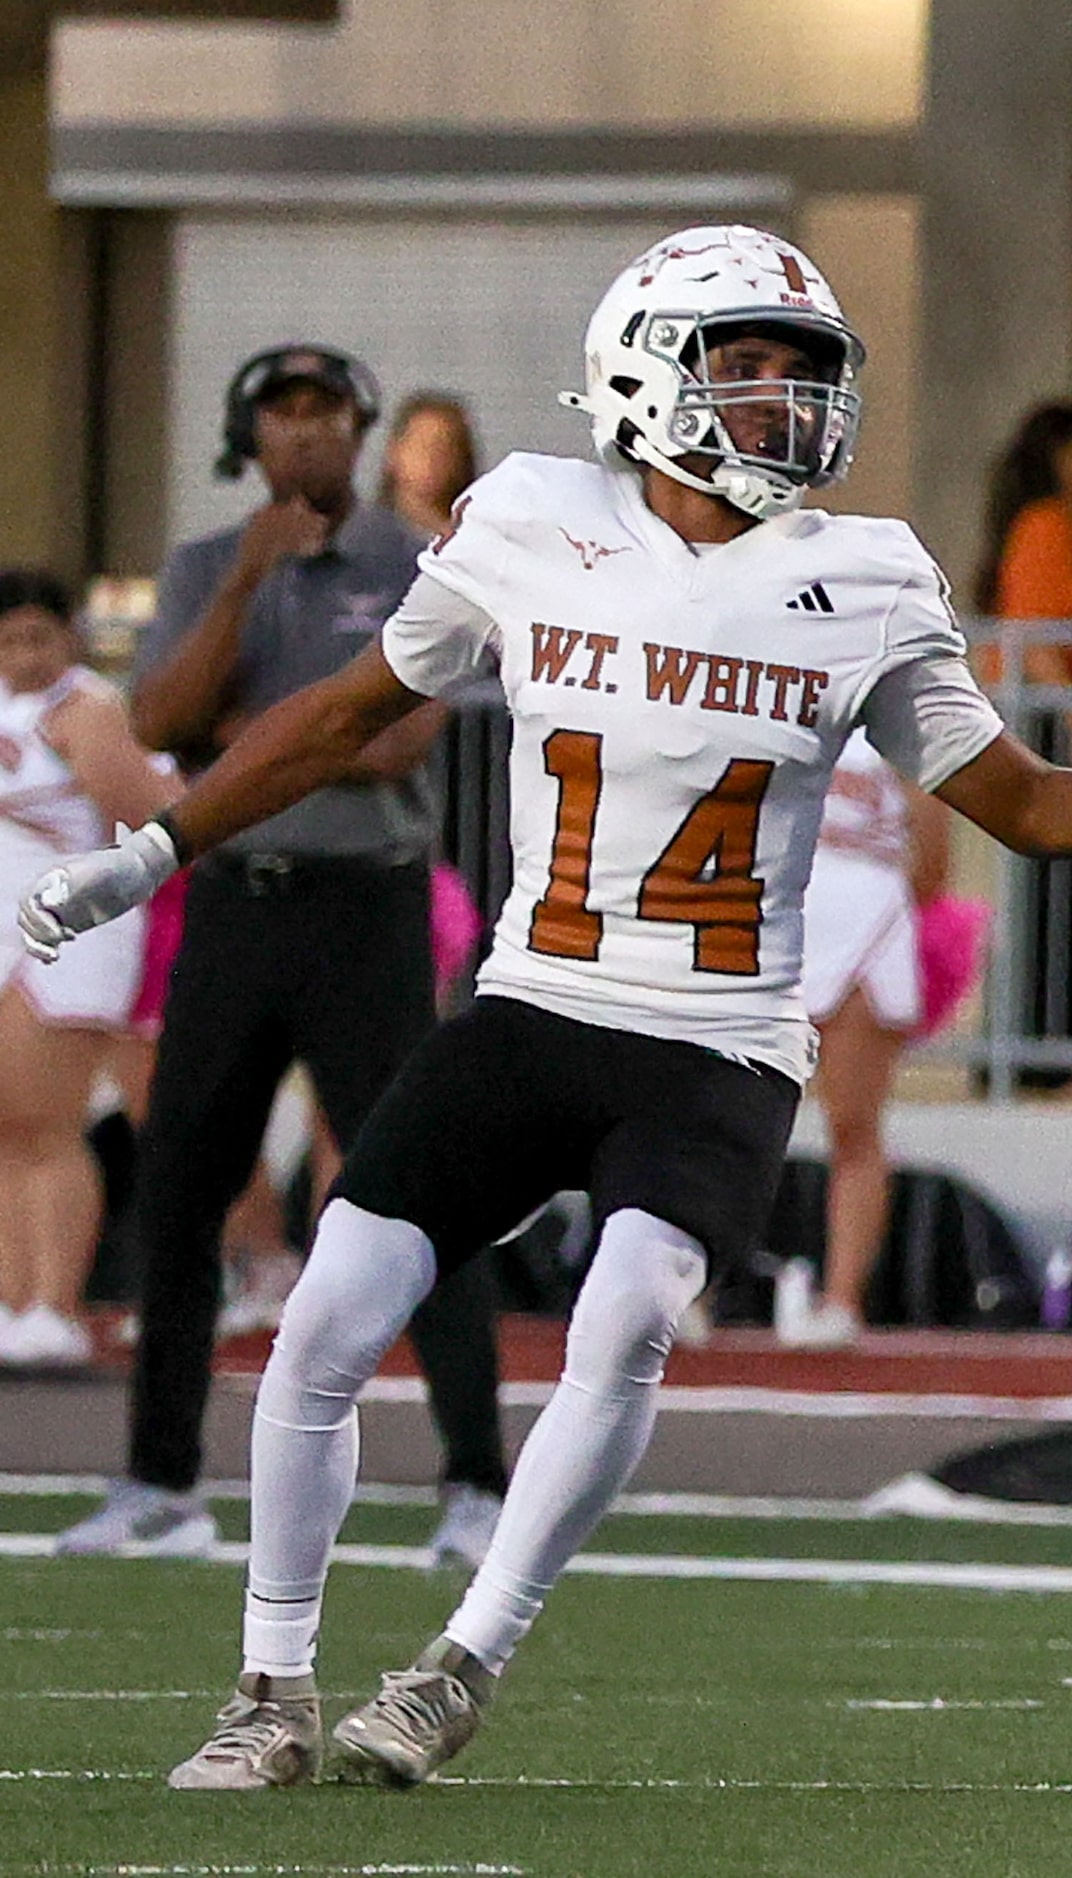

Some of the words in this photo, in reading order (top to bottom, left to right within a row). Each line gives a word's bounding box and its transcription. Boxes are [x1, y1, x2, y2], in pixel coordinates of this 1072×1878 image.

[530, 622, 619, 693] W.T.
[642, 642, 829, 727] WHITE
[528, 728, 775, 975] 14
